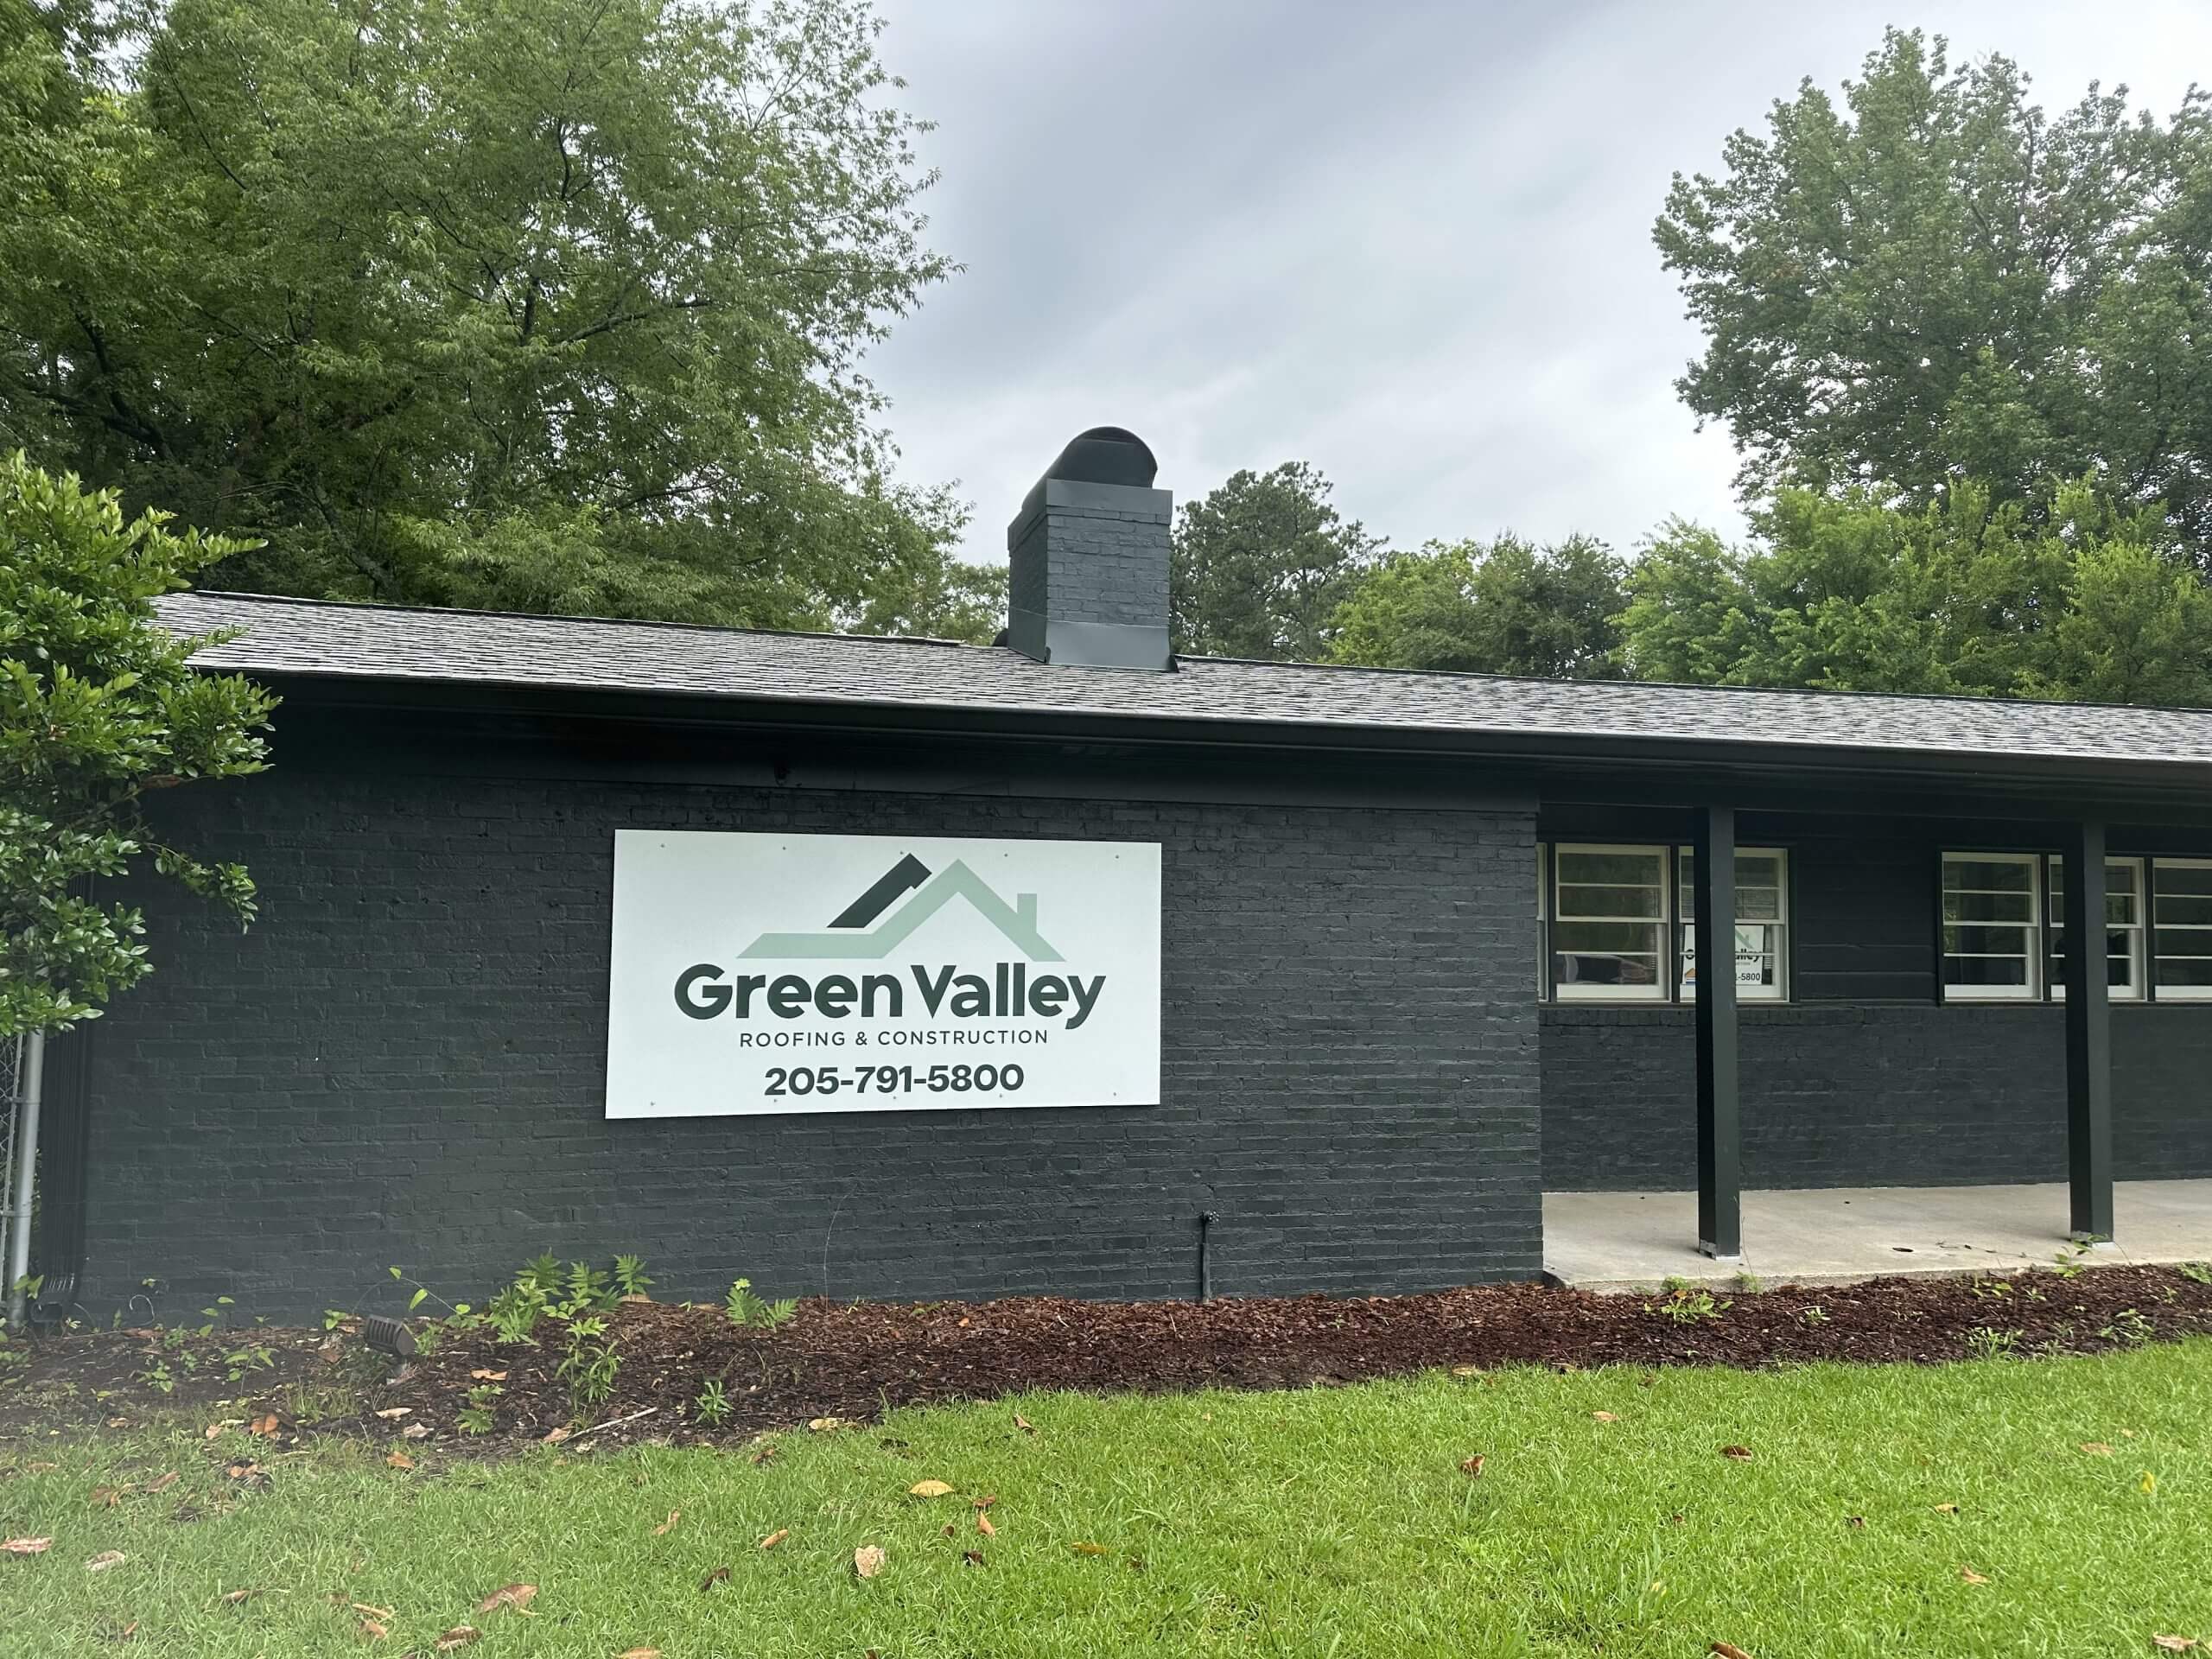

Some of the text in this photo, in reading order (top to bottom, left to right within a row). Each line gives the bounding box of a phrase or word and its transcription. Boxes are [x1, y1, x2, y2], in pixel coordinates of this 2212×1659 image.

[675, 963, 1106, 1029] Green Valley
[740, 1030, 1048, 1047] ROOFING & CONSTRUCTION
[765, 1064, 1024, 1095] 205-791-5800
